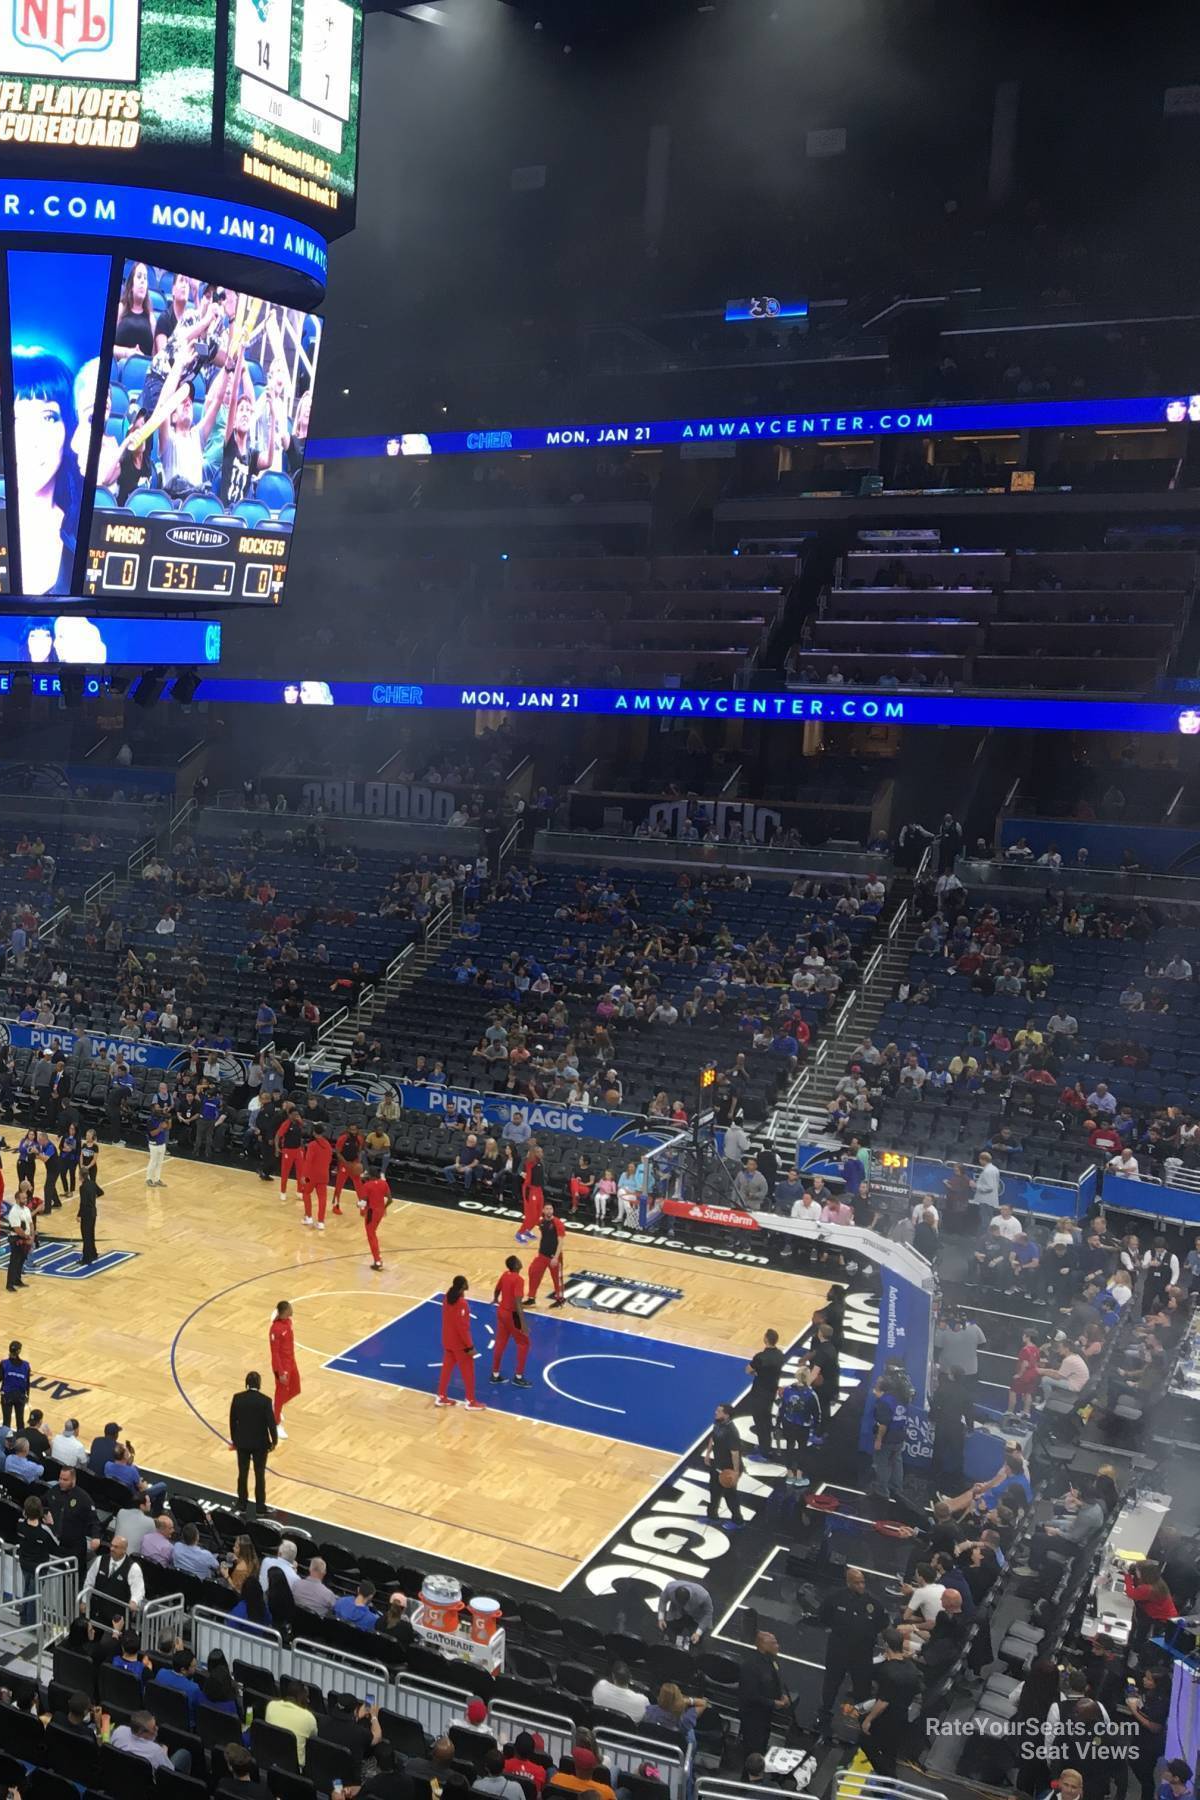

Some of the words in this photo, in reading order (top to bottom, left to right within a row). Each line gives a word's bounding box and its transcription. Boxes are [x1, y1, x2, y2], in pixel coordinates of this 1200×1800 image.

[20, 0, 106, 48] NFL
[258, 39, 270, 71] 14
[27, 83, 141, 119] PLAYOFFS
[152, 204, 211, 235] MON,
[219, 215, 254, 241] JAN
[259, 224, 275, 246] 21
[546, 430, 590, 445] MON,
[597, 428, 629, 443] JAN
[635, 428, 651, 441] 21
[682, 414, 934, 438] AMWAYCENTER.COM
[467, 431, 513, 449] CHER
[105, 524, 146, 545] MAGIC
[239, 537, 286, 557] ROCKETS
[122, 560, 133, 585] 0
[163, 562, 197, 588] 3:51
[258, 570, 268, 593] 0
[372, 685, 423, 704] CHER
[461, 690, 511, 708] MON,
[518, 691, 555, 708] JAN
[561, 693, 579, 708] 21
[615, 694, 904, 718] AMWAYCENTER.COM
[429, 1092, 485, 1116] PURE
[508, 1103, 585, 1133] MAGIC
[564, 1281, 667, 1316] RDV
[888, 1284, 900, 1349] AdventHealth
[475, 1618, 485, 1629] G
[426, 1631, 474, 1653] GATORADE
